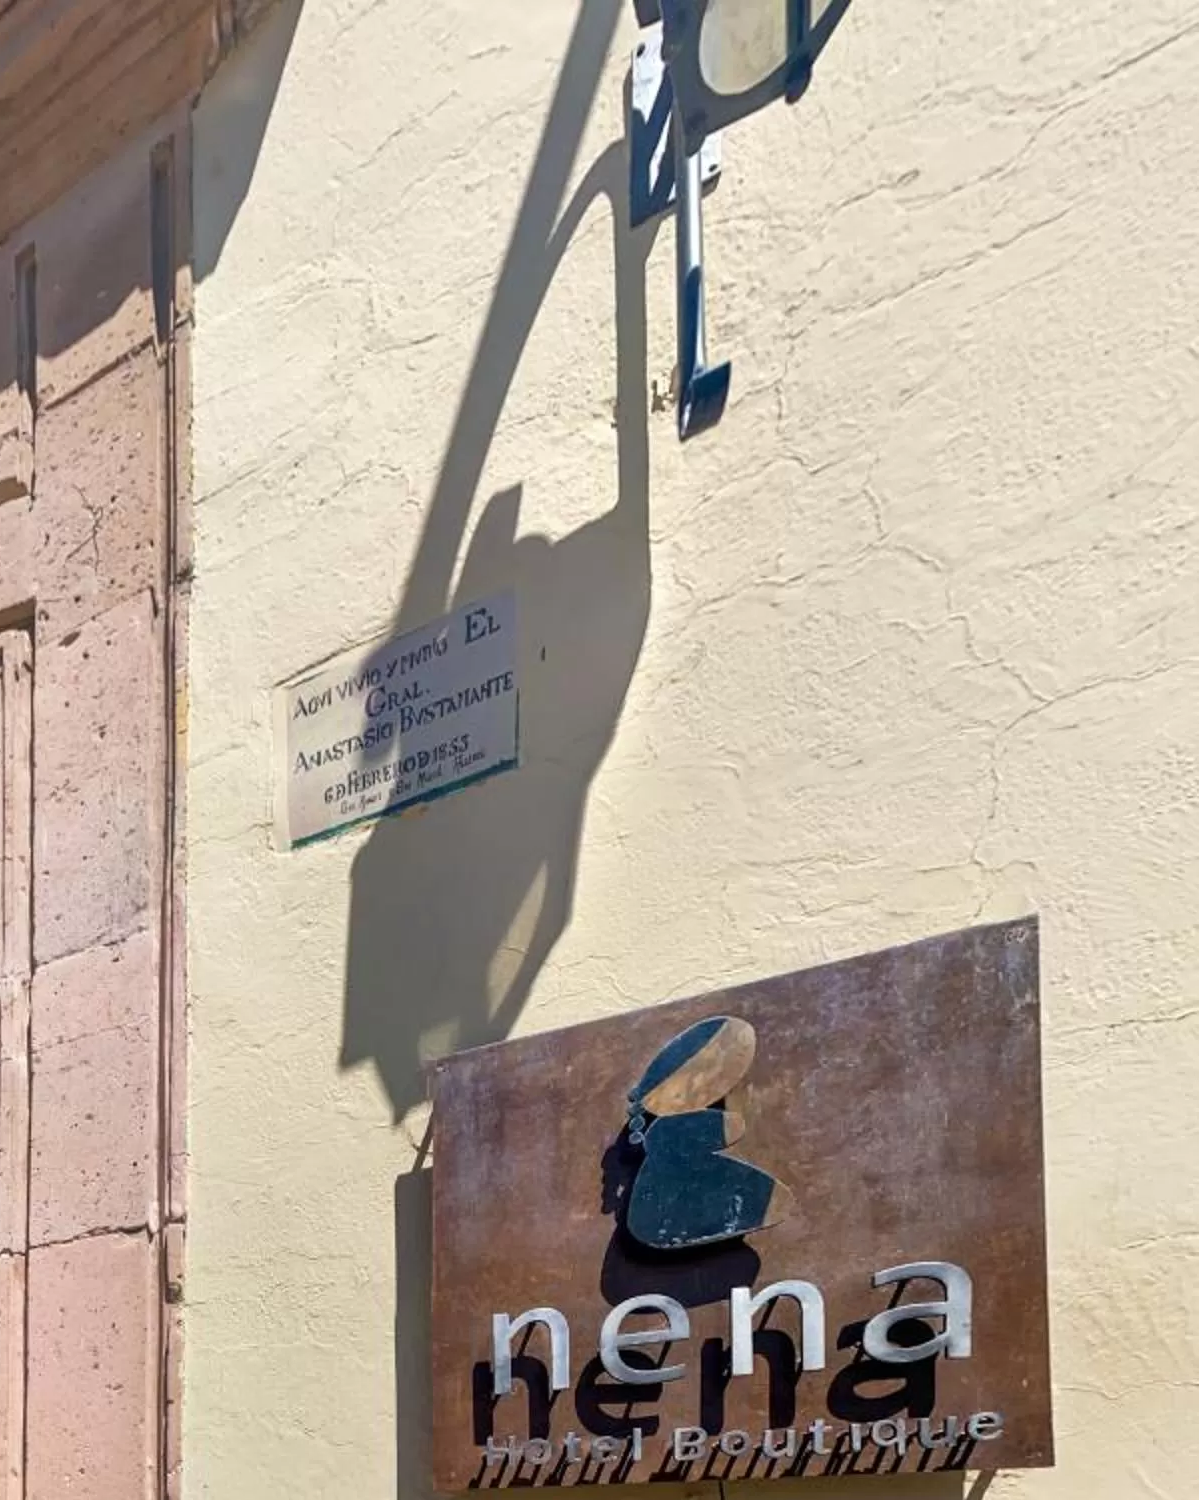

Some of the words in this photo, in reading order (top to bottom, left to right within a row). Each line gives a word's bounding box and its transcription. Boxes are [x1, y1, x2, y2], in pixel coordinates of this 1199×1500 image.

[491, 1261, 973, 1395] nena
[483, 1427, 643, 1467] Hotel
[673, 1411, 1004, 1461] Boutique
